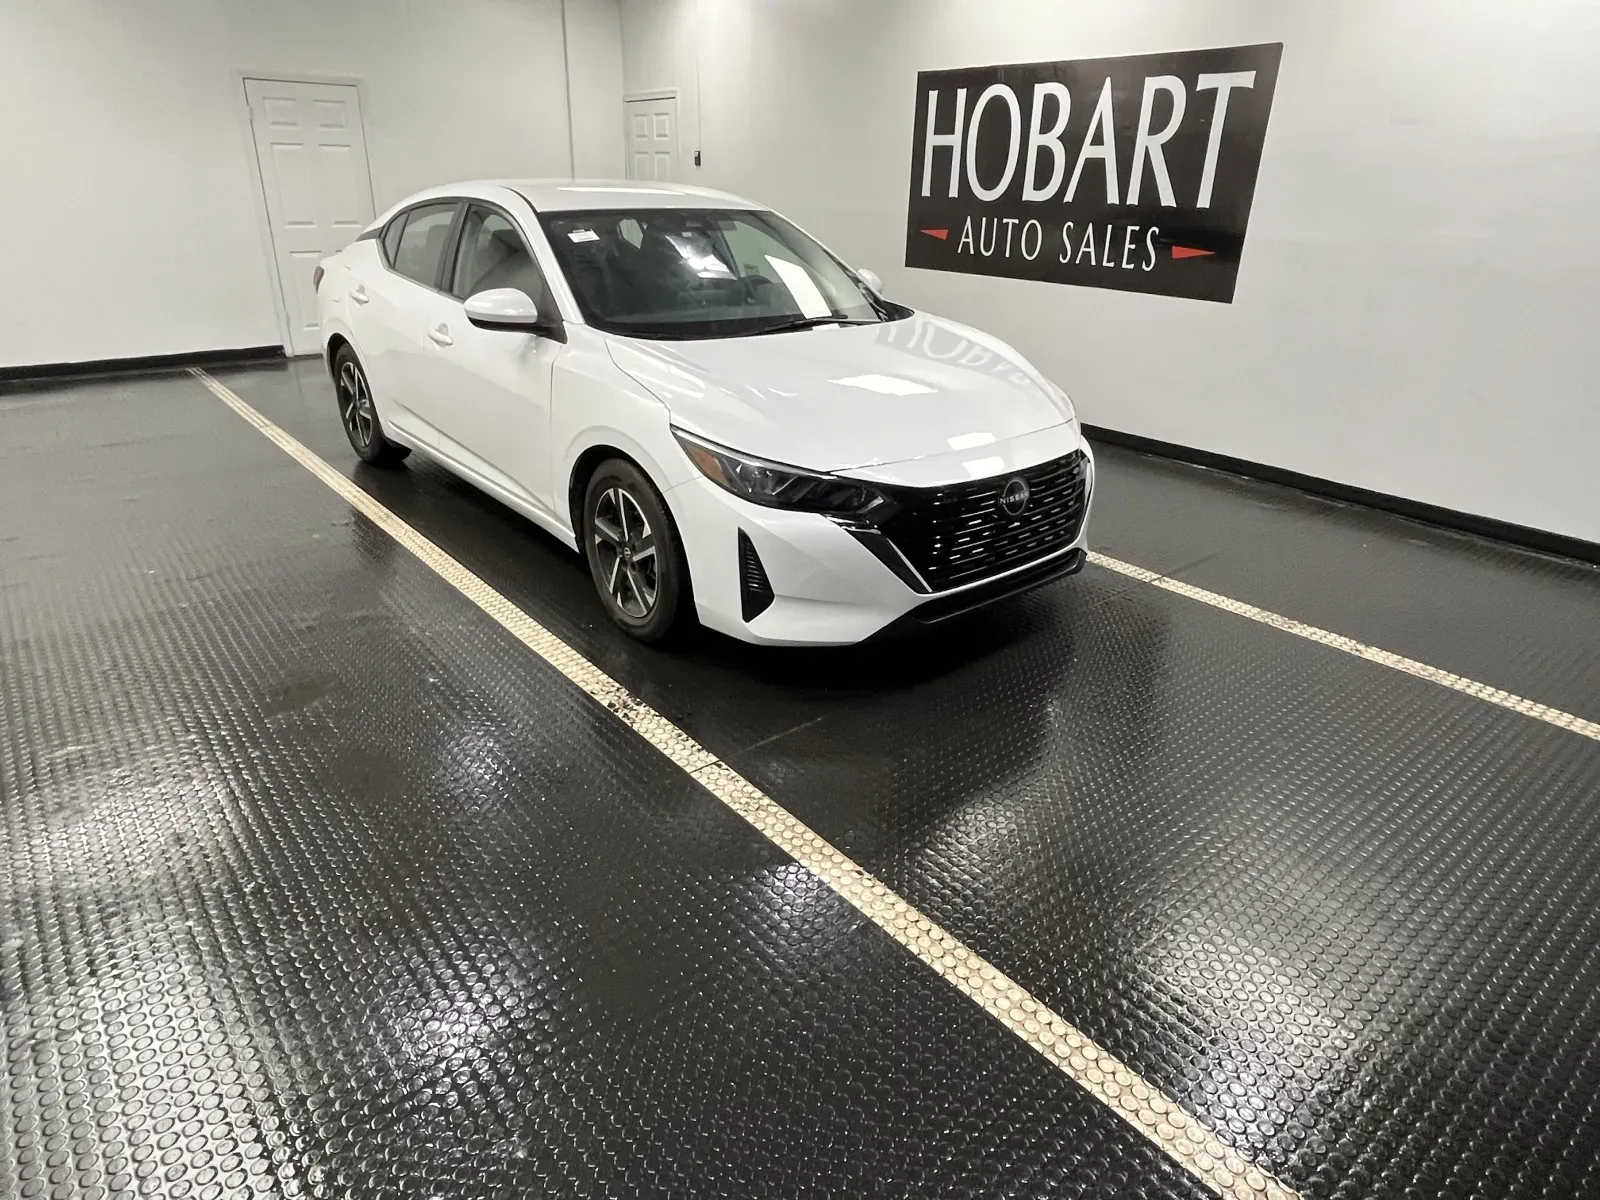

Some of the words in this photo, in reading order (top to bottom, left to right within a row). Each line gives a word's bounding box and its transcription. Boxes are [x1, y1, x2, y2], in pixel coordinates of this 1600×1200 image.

[921, 70, 1256, 209] HOBART
[957, 216, 1042, 261] AUTO
[1060, 221, 1160, 272] SALES
